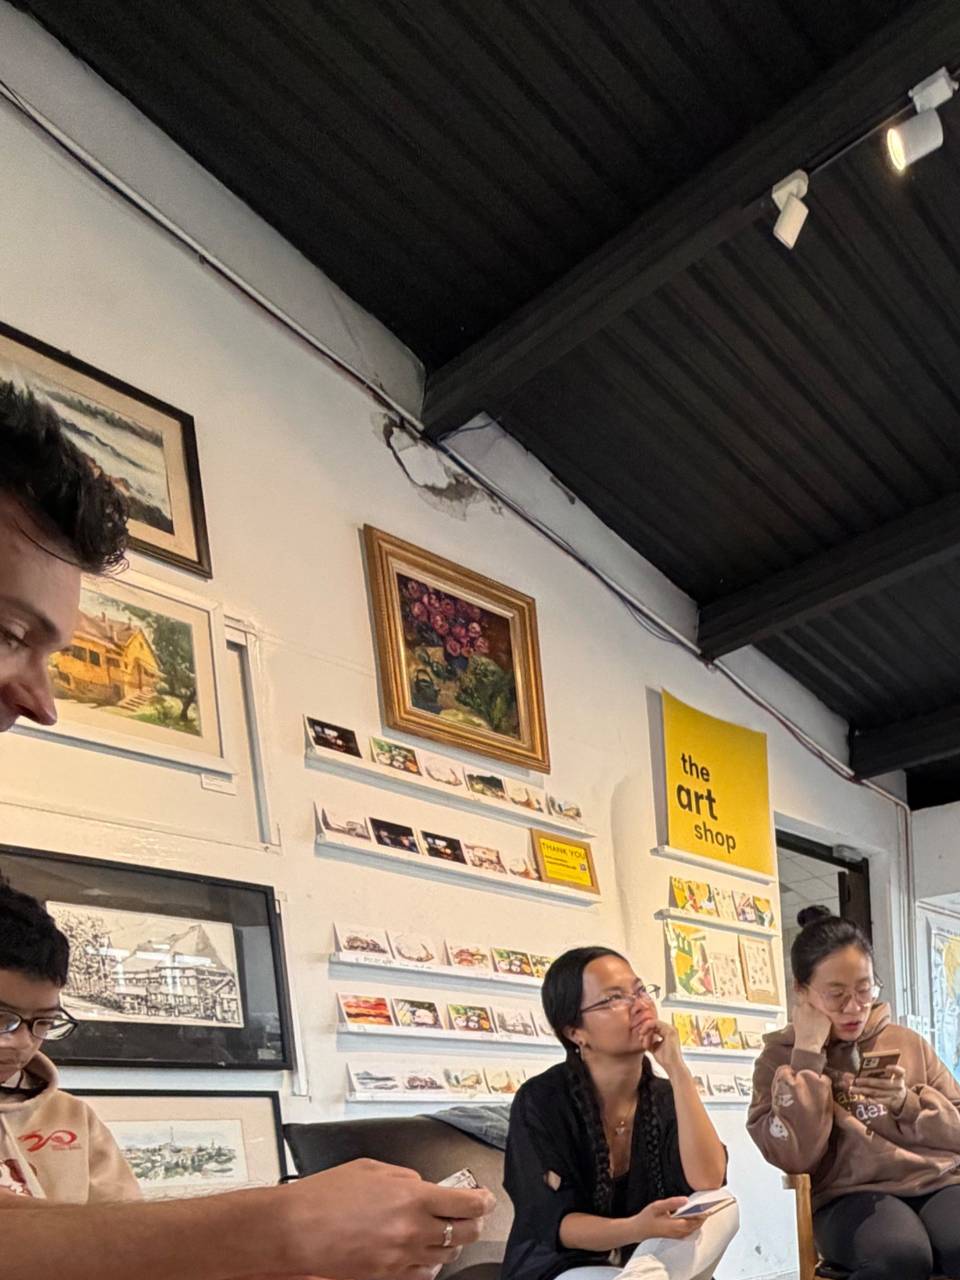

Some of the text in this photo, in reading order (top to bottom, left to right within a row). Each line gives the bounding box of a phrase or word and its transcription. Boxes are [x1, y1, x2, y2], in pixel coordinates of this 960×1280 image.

[681, 752, 710, 782] the
[676, 784, 718, 821] art
[694, 821, 736, 854] shop
